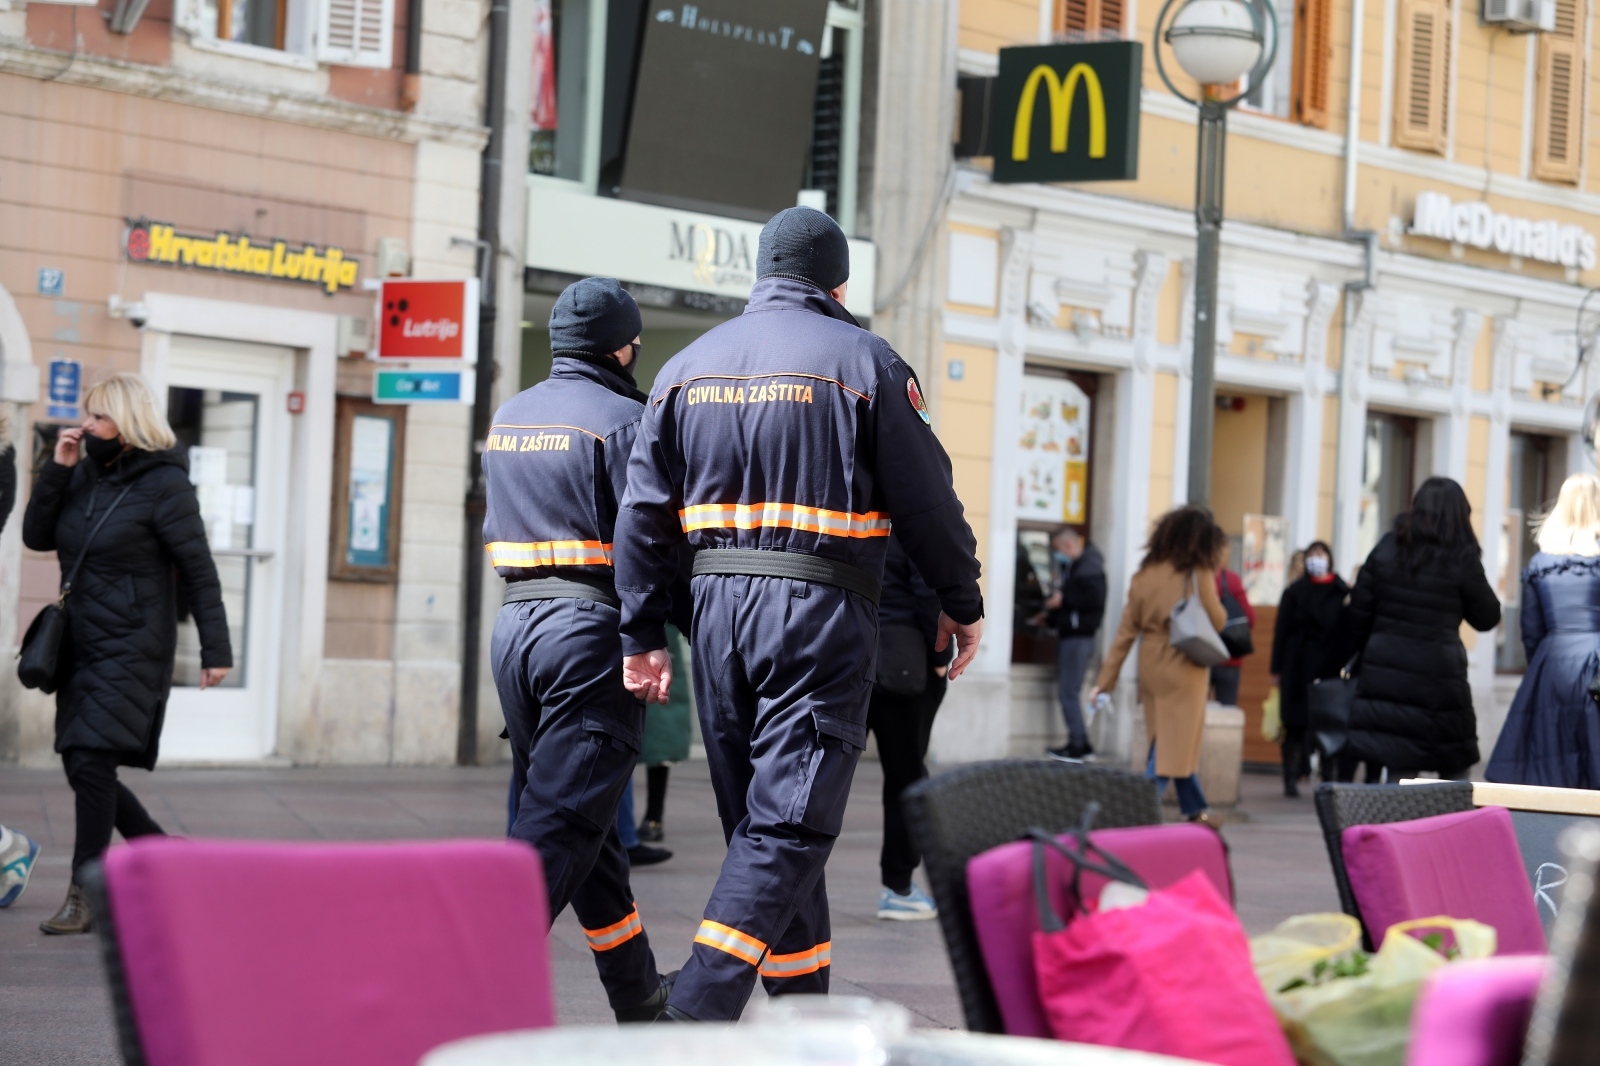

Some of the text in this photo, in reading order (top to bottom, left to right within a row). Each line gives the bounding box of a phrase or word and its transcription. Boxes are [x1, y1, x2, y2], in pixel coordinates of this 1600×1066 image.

[1414, 191, 1596, 271] McDonald's
[402, 317, 459, 341] Lutrija
[687, 380, 813, 405] CIVILNA ZAŠTITA
[519, 431, 569, 452] ZAŠTITA
